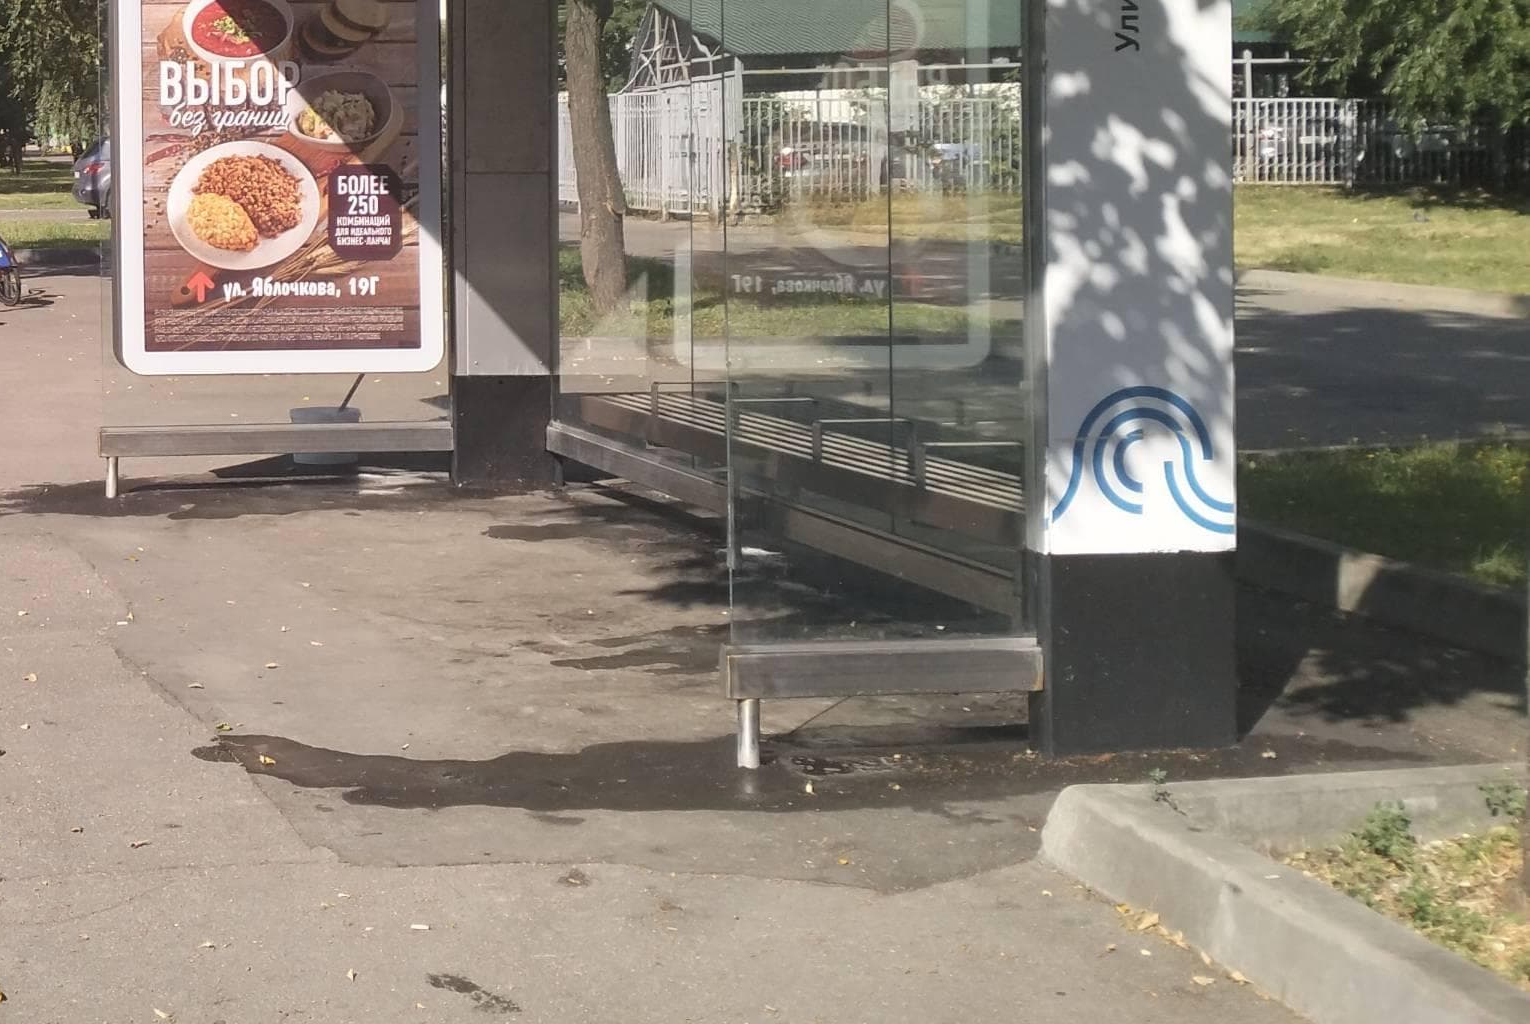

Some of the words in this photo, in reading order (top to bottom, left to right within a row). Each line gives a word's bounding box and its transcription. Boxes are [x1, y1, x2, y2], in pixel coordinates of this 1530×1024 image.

[159, 60, 301, 106] ВЫБОР
[170, 102, 207, 136] без
[211, 109, 292, 132] границ
[337, 175, 390, 195] БОЛЕЕ
[348, 195, 379, 215] 250
[336, 214, 391, 227] КОМБИНАЦИЙ
[335, 227, 349, 237] ДЛЯ
[350, 227, 392, 236] ИДЕАЛЬНОГО
[223, 279, 247, 302] ул.
[252, 276, 341, 298] Яблочкова,
[349, 277, 379, 296] 19Г
